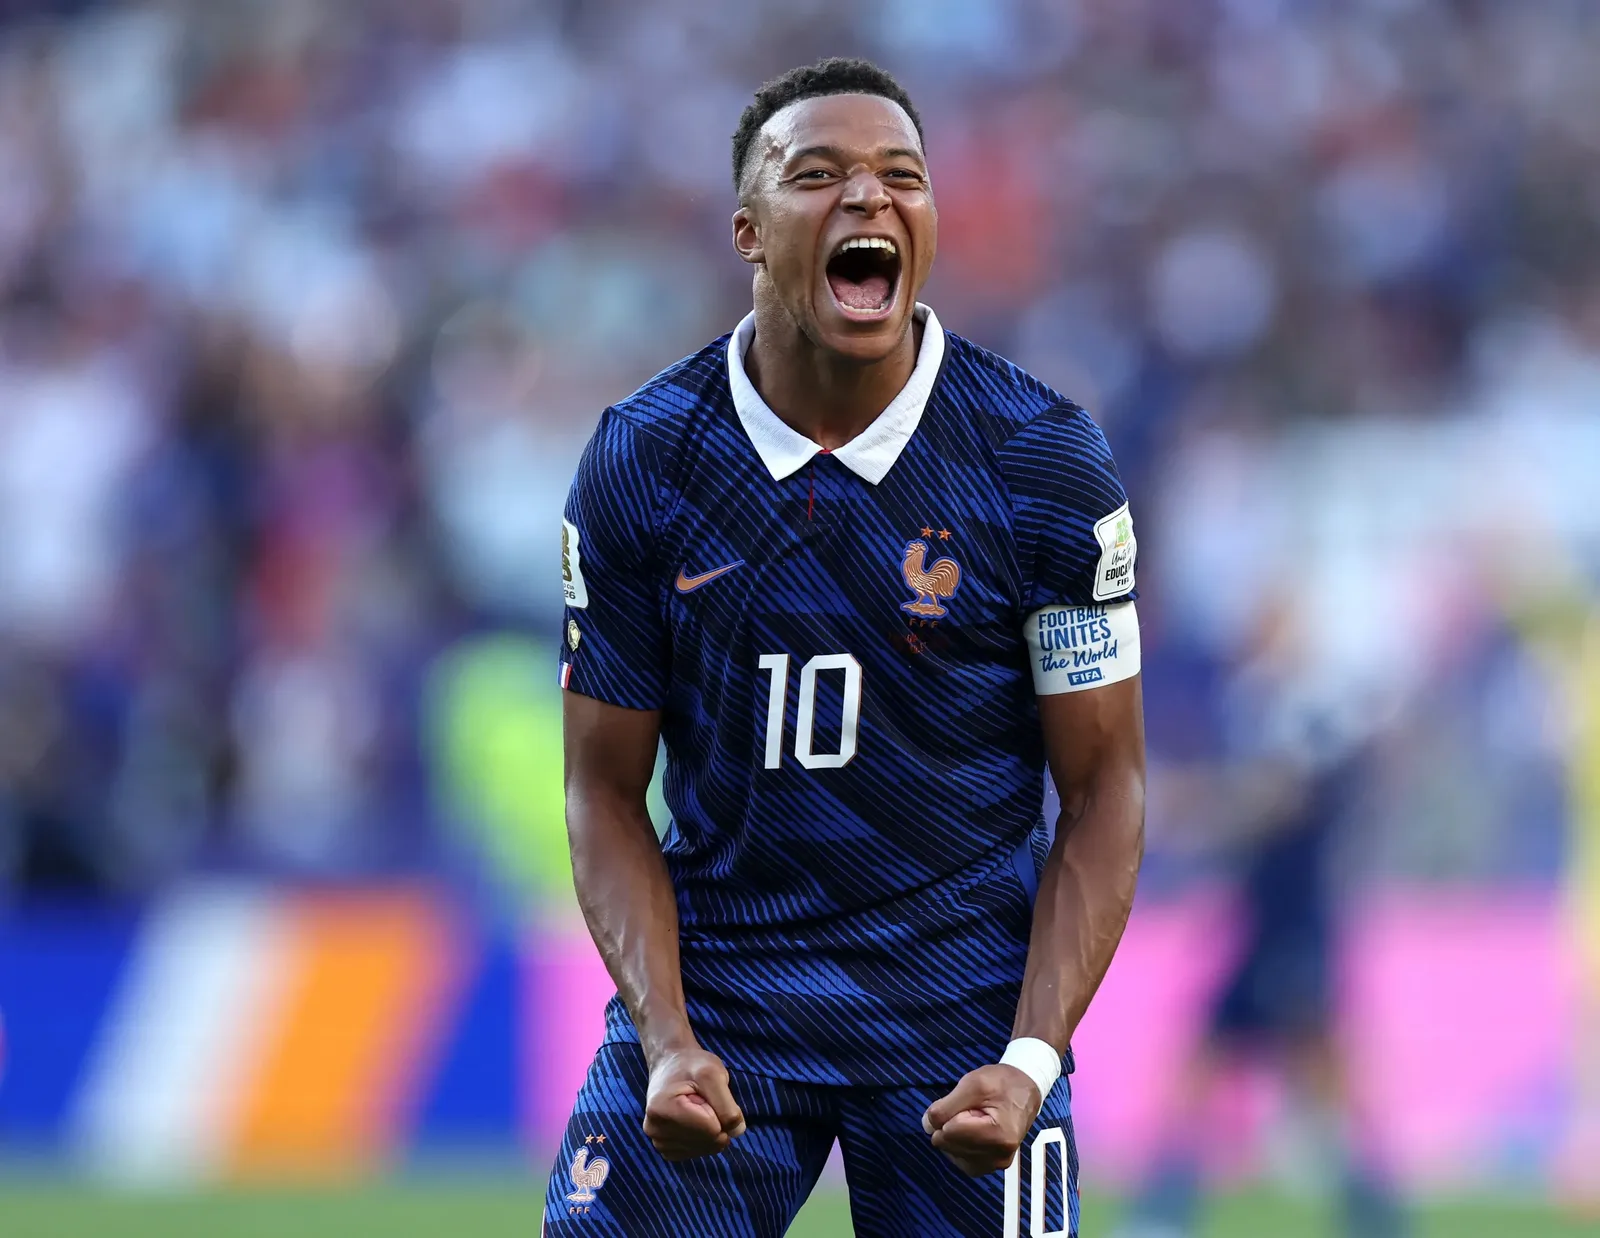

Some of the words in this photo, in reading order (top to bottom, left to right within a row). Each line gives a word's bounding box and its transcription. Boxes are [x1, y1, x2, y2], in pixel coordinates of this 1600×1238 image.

[1038, 604, 1107, 630] FOOTBALL
[1038, 618, 1112, 652] UNITES
[1039, 652, 1070, 672] the
[1072, 639, 1118, 668] World
[1070, 670, 1101, 684] FIFA
[758, 653, 863, 769] 10
[1003, 1126, 1069, 1238] 10
